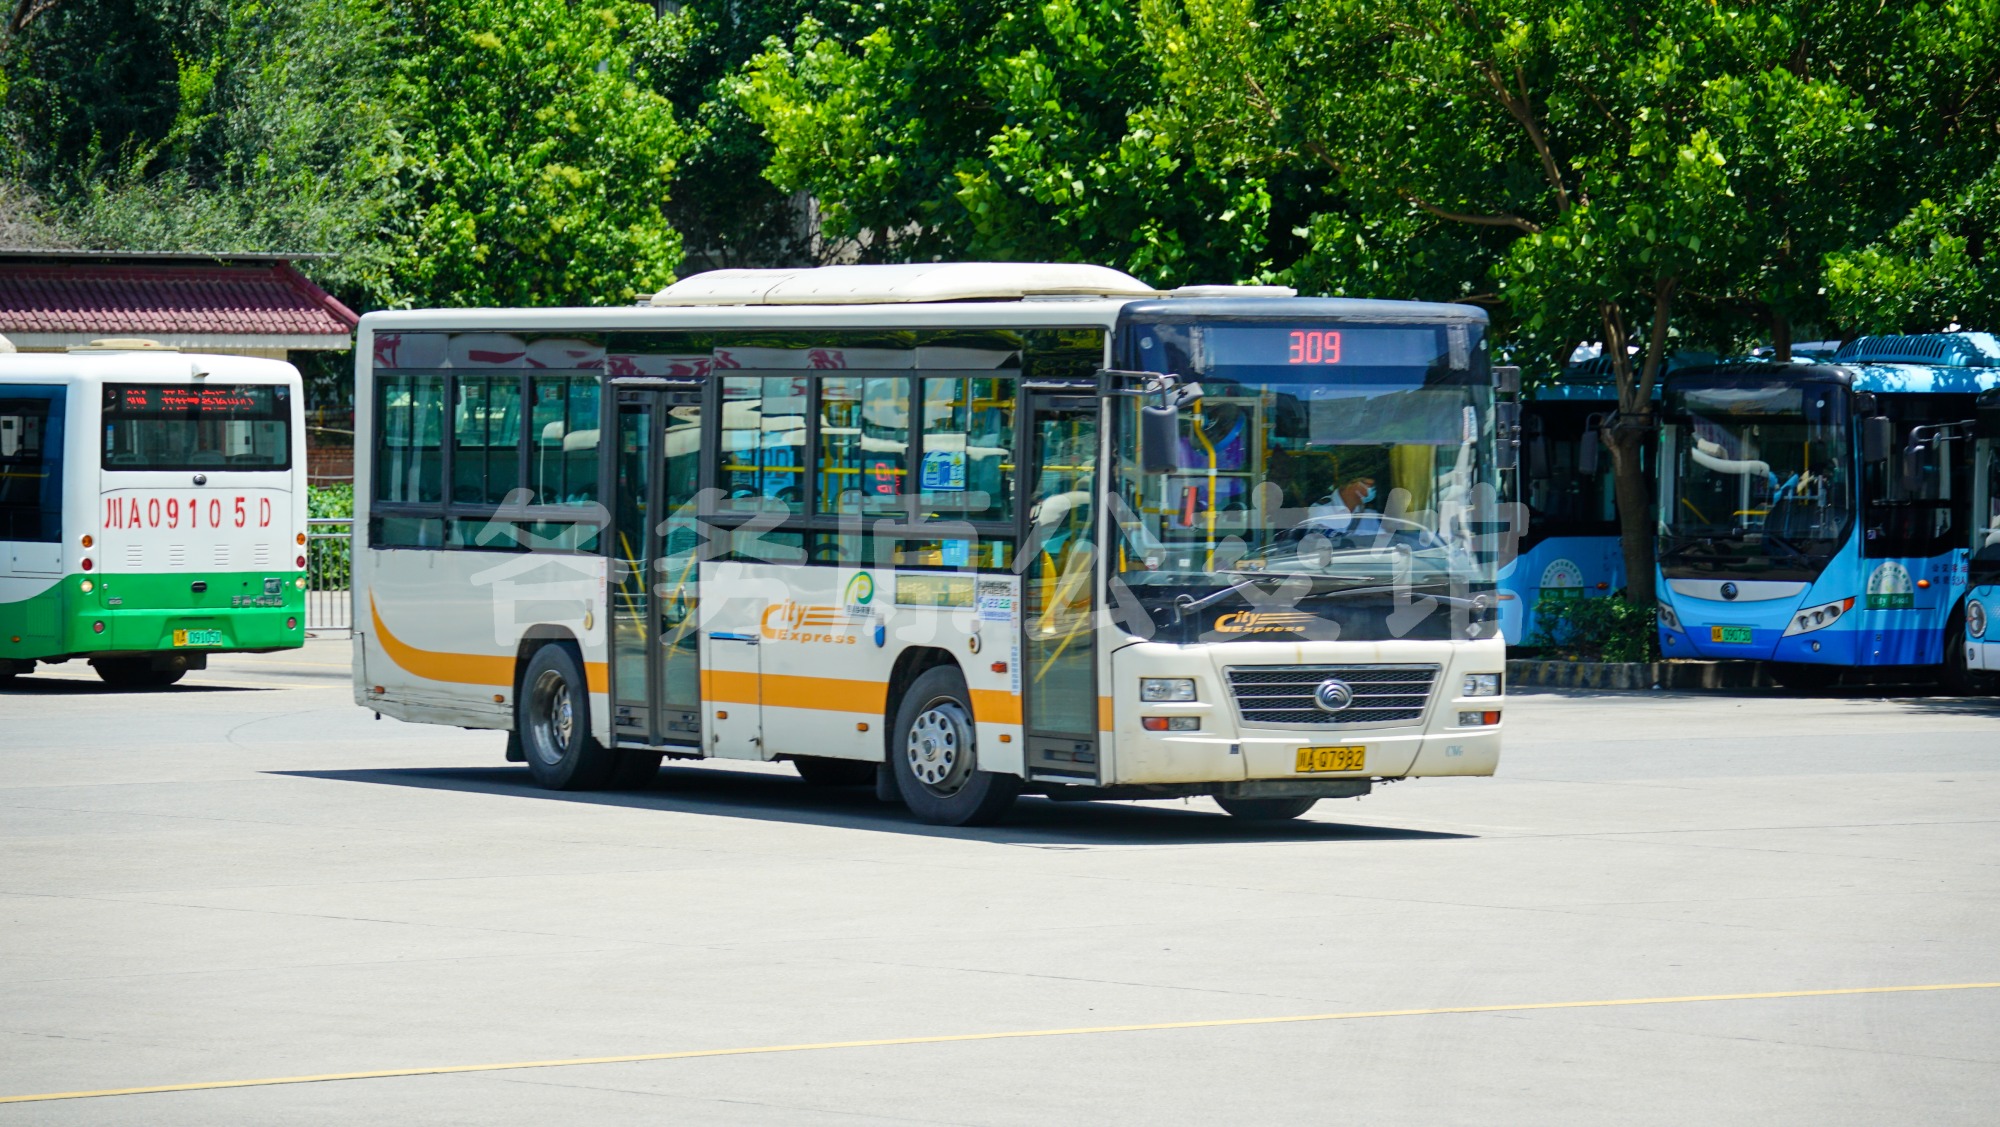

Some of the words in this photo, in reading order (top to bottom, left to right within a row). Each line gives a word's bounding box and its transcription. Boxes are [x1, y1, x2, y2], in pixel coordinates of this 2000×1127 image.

[1289, 331, 1341, 364] 309
[761, 599, 807, 639] City
[1213, 610, 1260, 633] City
[1231, 625, 1306, 634] Express
[778, 629, 857, 645] Express
